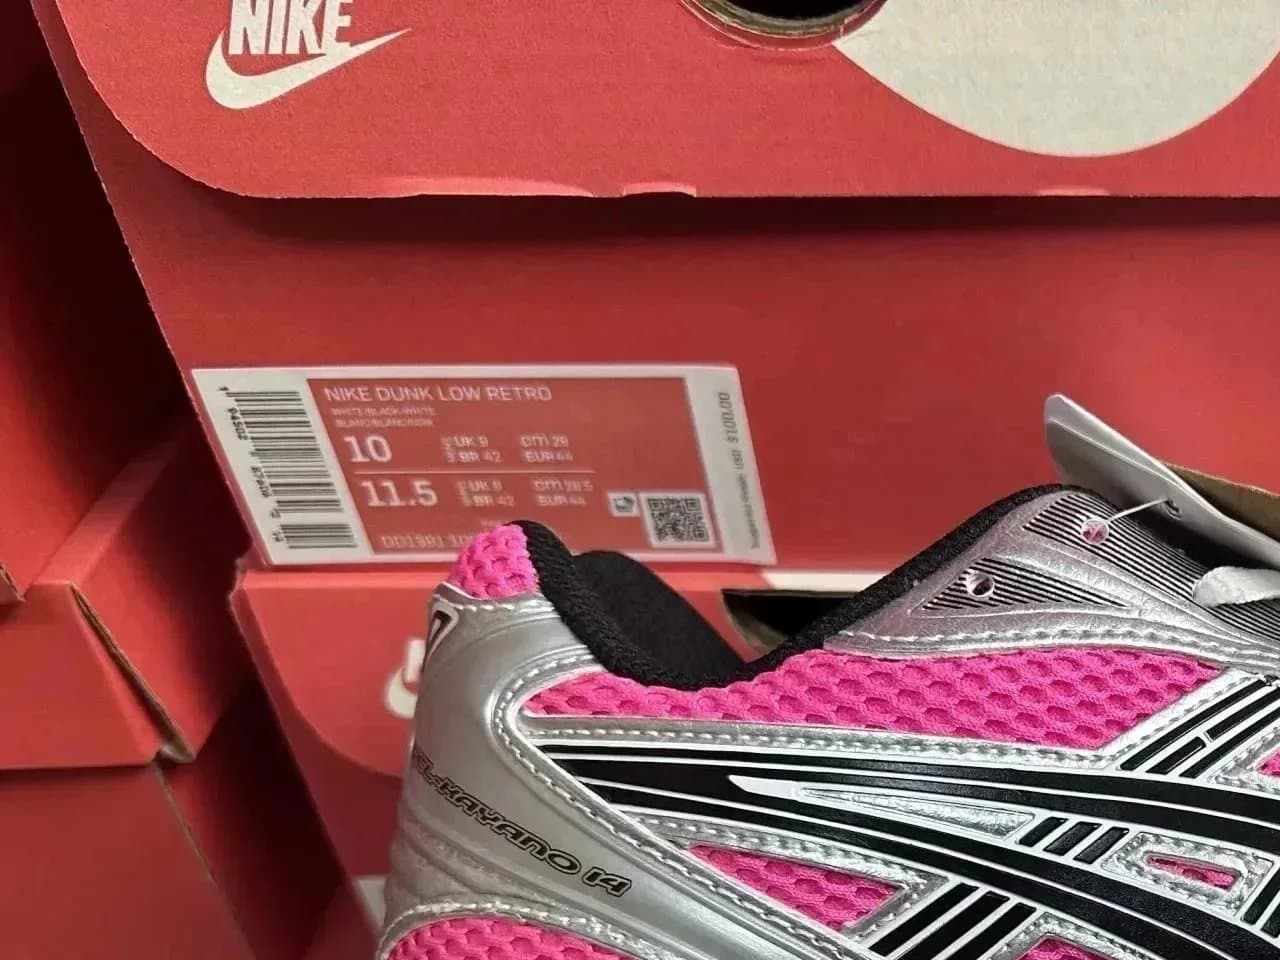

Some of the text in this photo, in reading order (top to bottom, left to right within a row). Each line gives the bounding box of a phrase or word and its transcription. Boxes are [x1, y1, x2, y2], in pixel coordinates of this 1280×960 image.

[228, 0, 351, 55] NIKE
[324, 385, 552, 401] NIKE DUNK LOW RETRO
[343, 435, 392, 462] 10
[453, 436, 474, 447] UK
[525, 451, 553, 462] EUR
[361, 480, 438, 507] 11.5
[414, 751, 632, 898] EL-KAYANO 14
